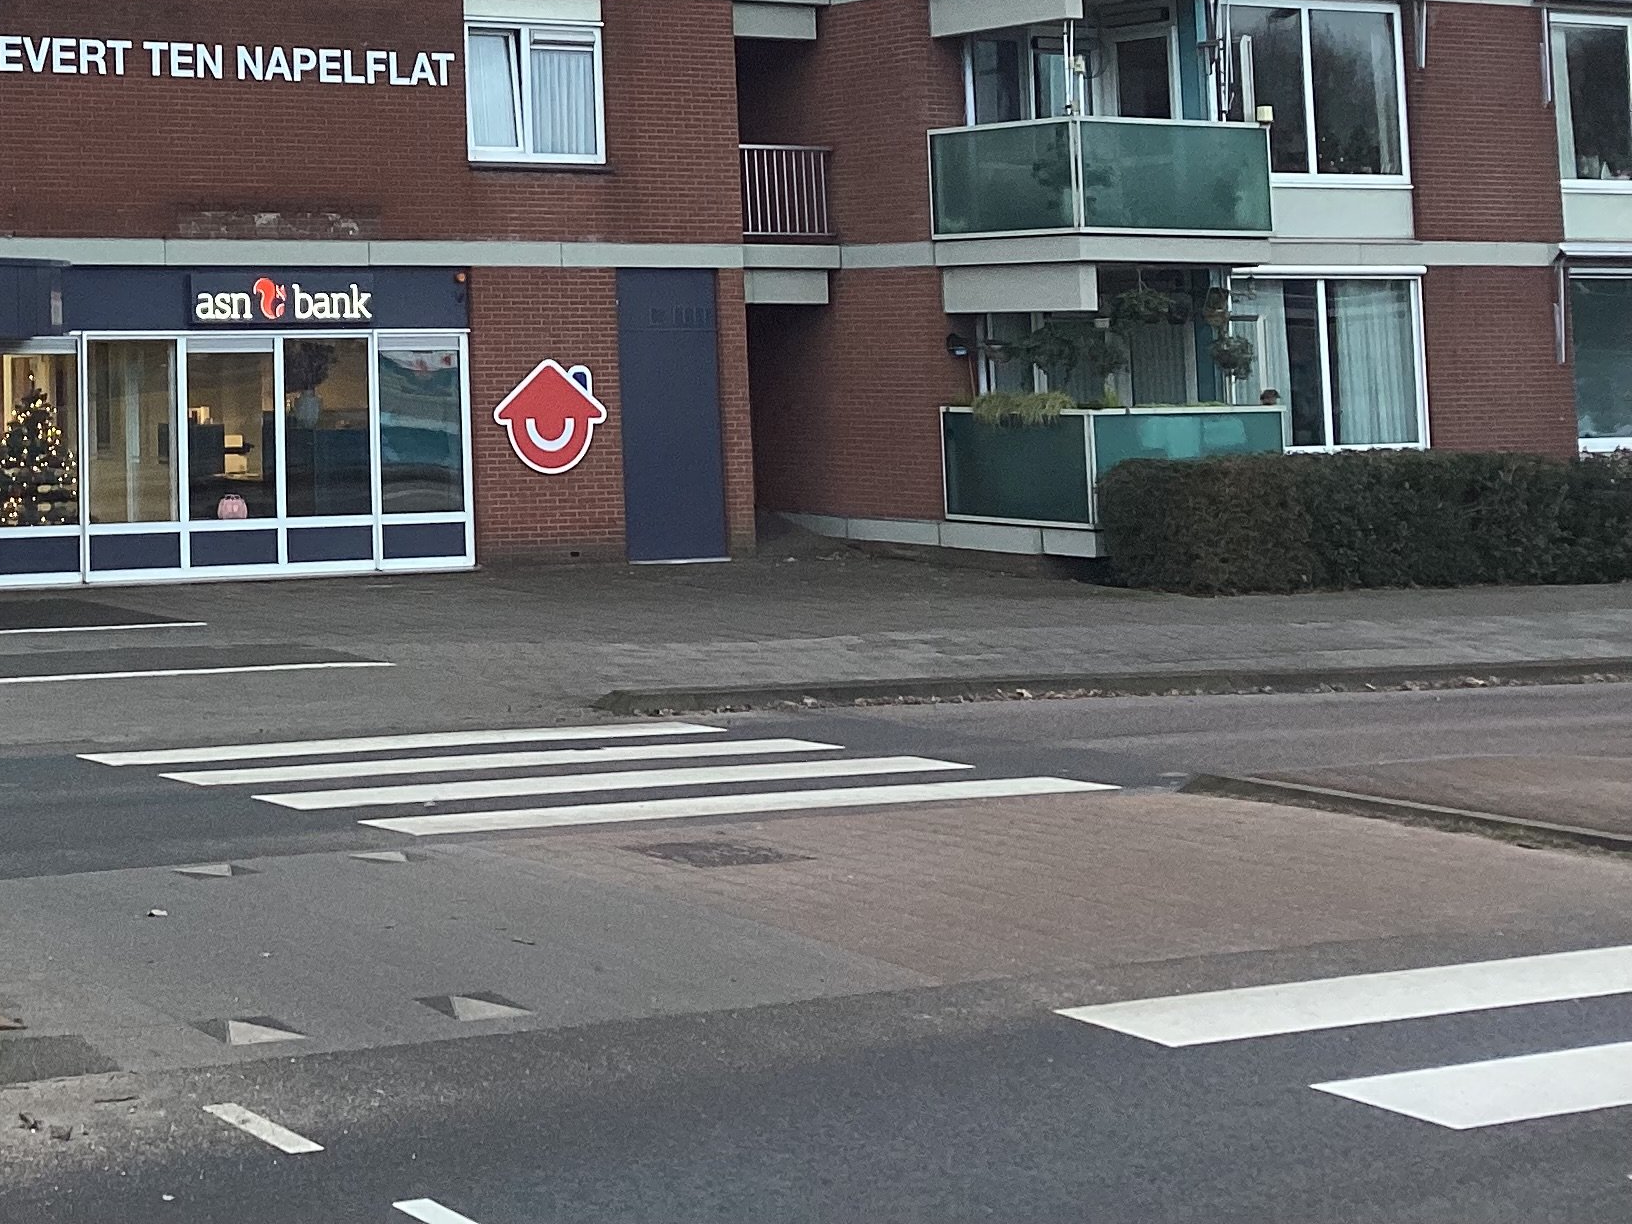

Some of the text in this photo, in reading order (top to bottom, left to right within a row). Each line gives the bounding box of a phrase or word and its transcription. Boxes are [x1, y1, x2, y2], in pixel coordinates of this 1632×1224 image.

[142, 41, 223, 80] TEN
[236, 45, 455, 87] NAPELFLAT
[195, 283, 373, 320] asn bank
